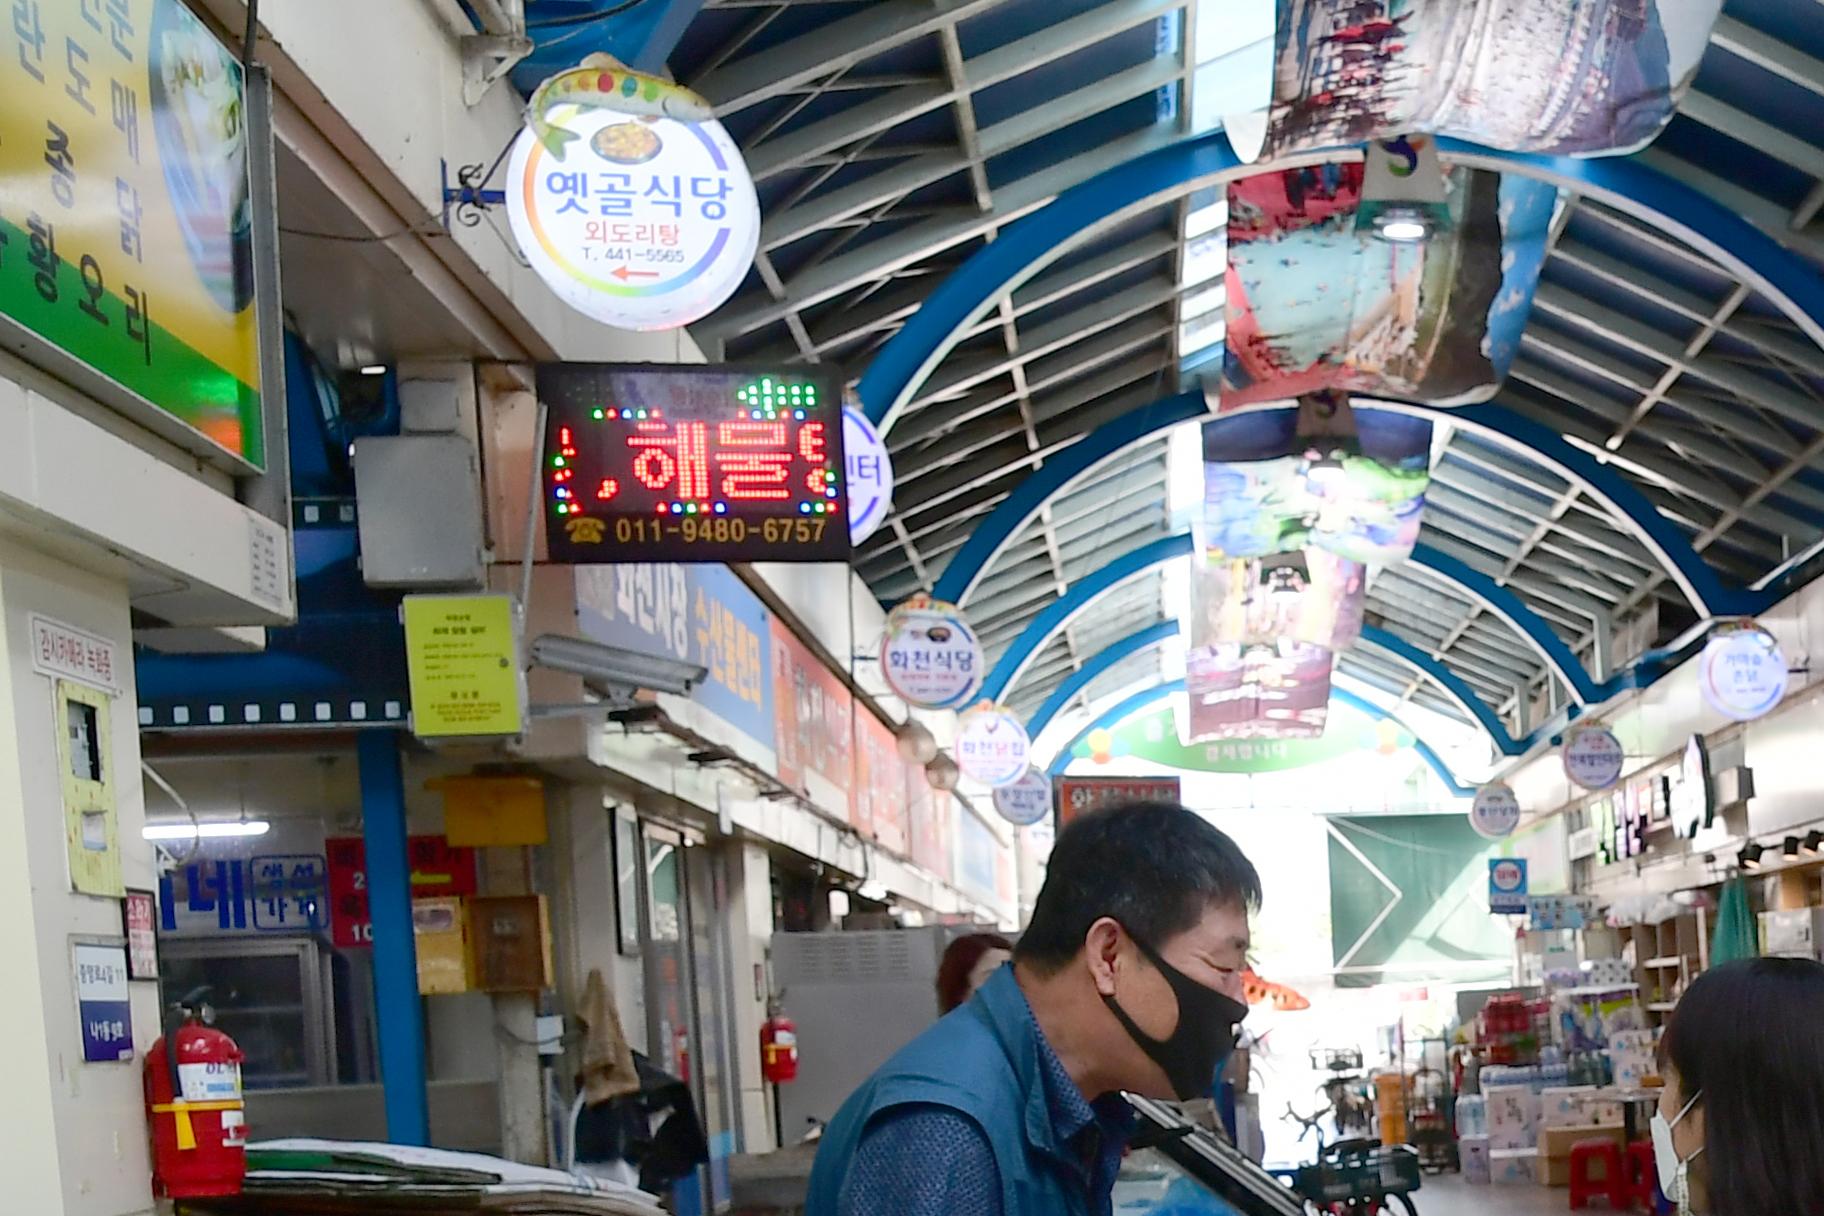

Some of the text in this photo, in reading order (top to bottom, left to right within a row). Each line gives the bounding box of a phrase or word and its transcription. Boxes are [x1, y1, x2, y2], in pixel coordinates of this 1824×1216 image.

[546, 171, 734, 220] 옛골식당
[584, 220, 680, 247] 외도리탕
[615, 517, 827, 543] 011-9480-6757
[889, 651, 974, 673] 화천식당
